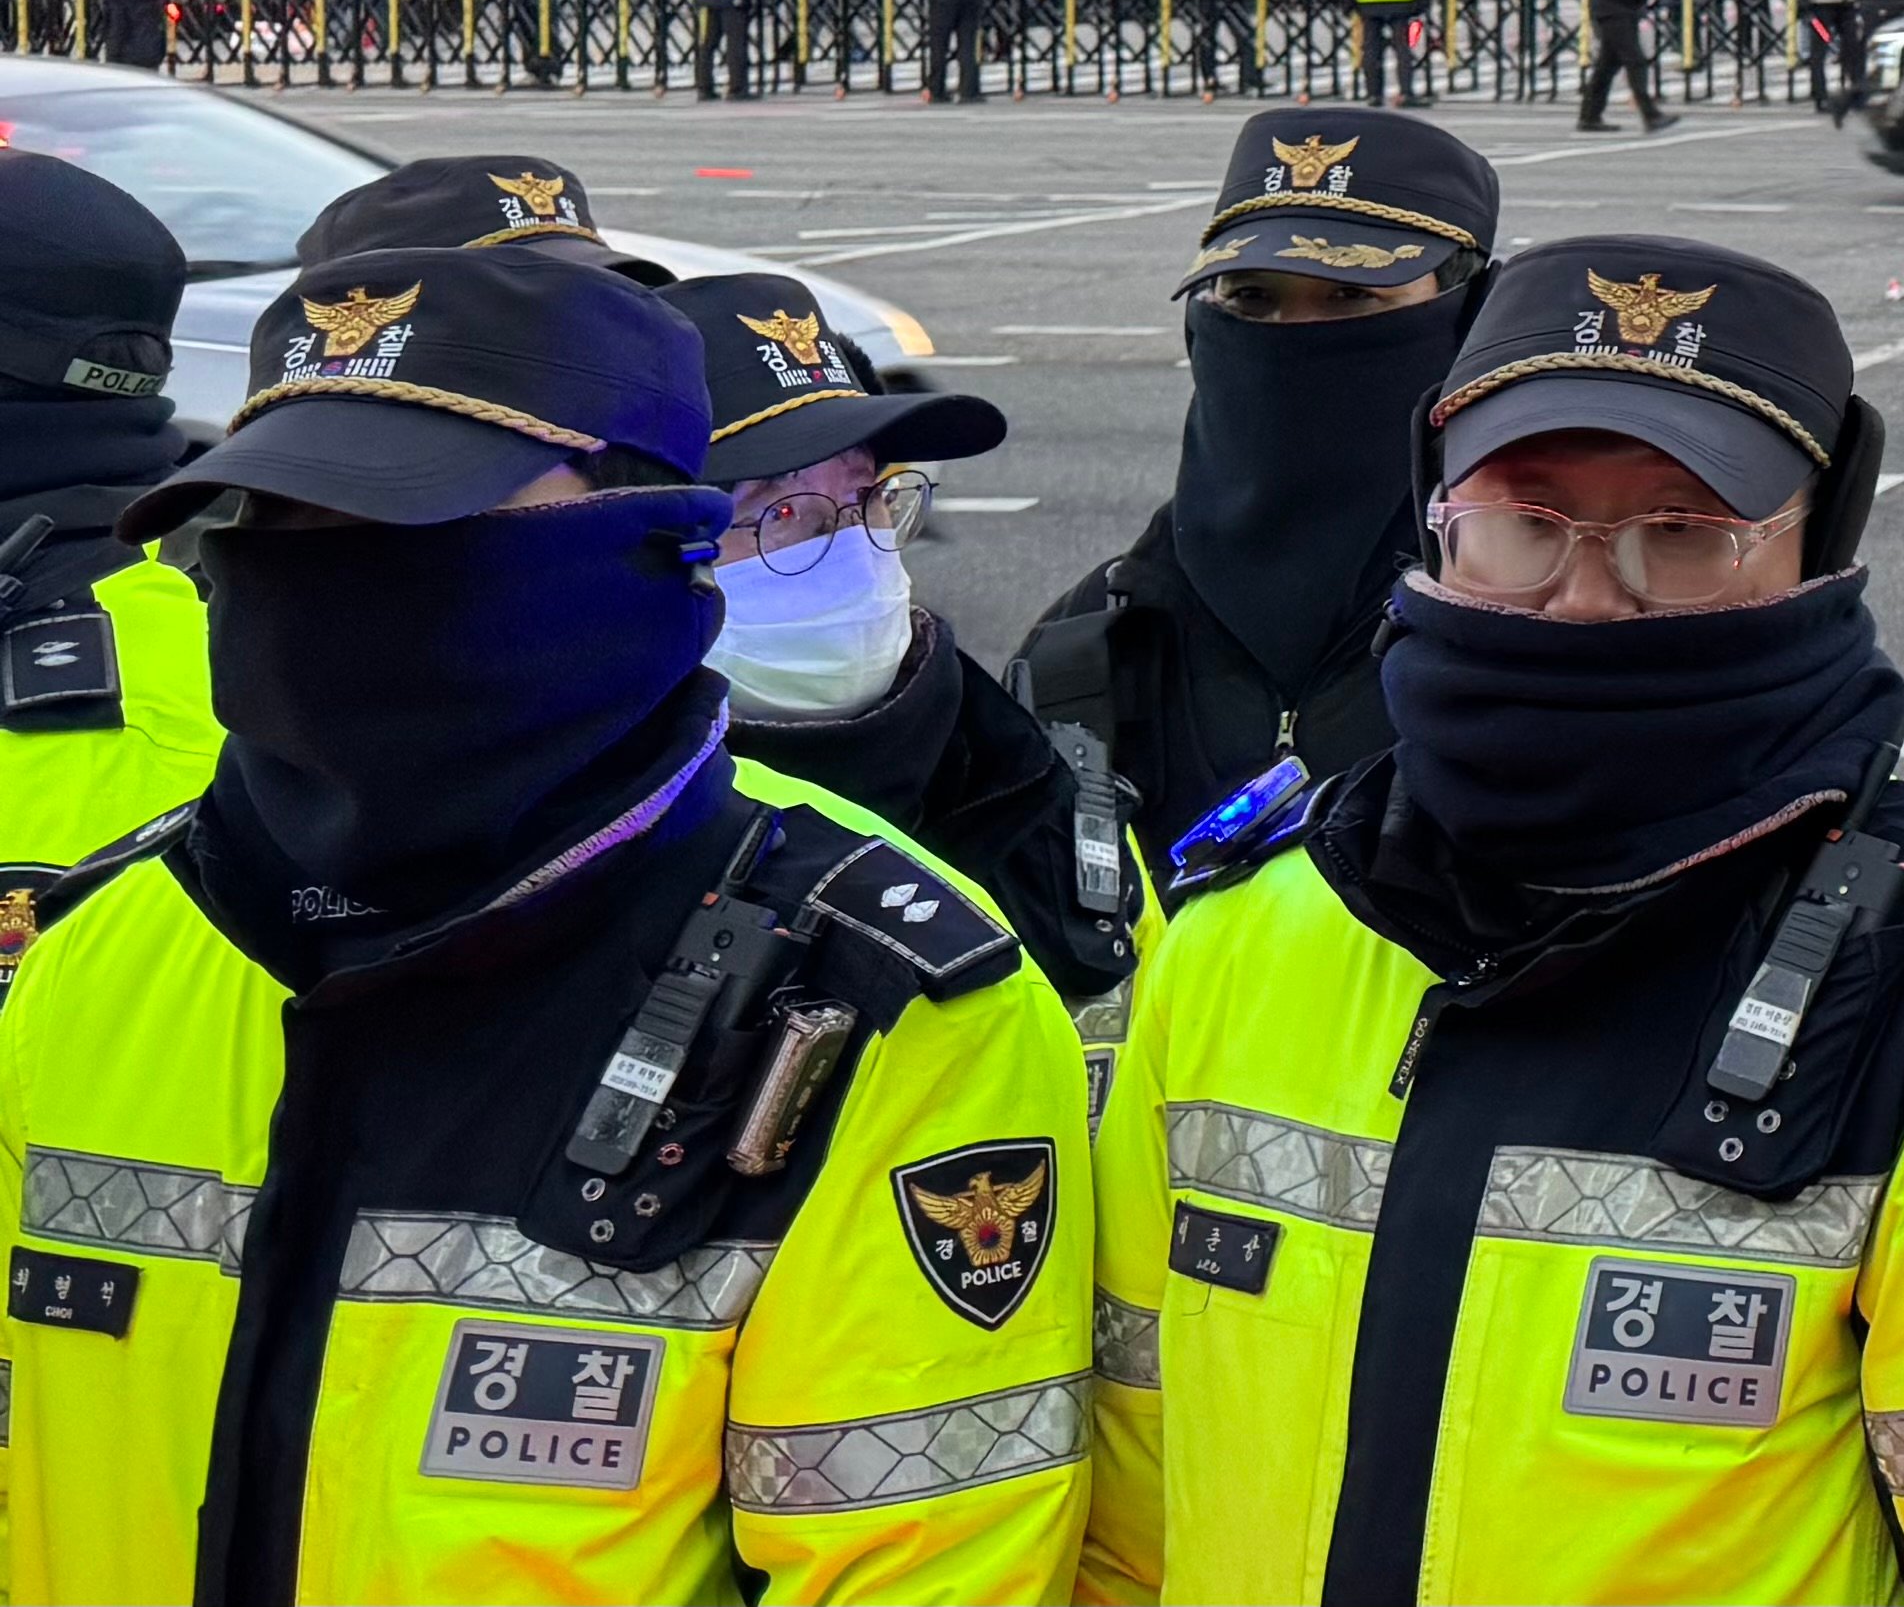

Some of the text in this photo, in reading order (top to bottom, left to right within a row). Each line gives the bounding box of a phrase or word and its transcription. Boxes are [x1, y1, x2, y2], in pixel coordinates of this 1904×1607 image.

[960, 1260, 1022, 1289] POLICE
[1604, 1278, 1768, 1361] 경찰
[468, 1341, 636, 1424] 경찰
[1589, 1363, 1758, 1408] POLICE
[444, 1425, 625, 1470] POLICE
